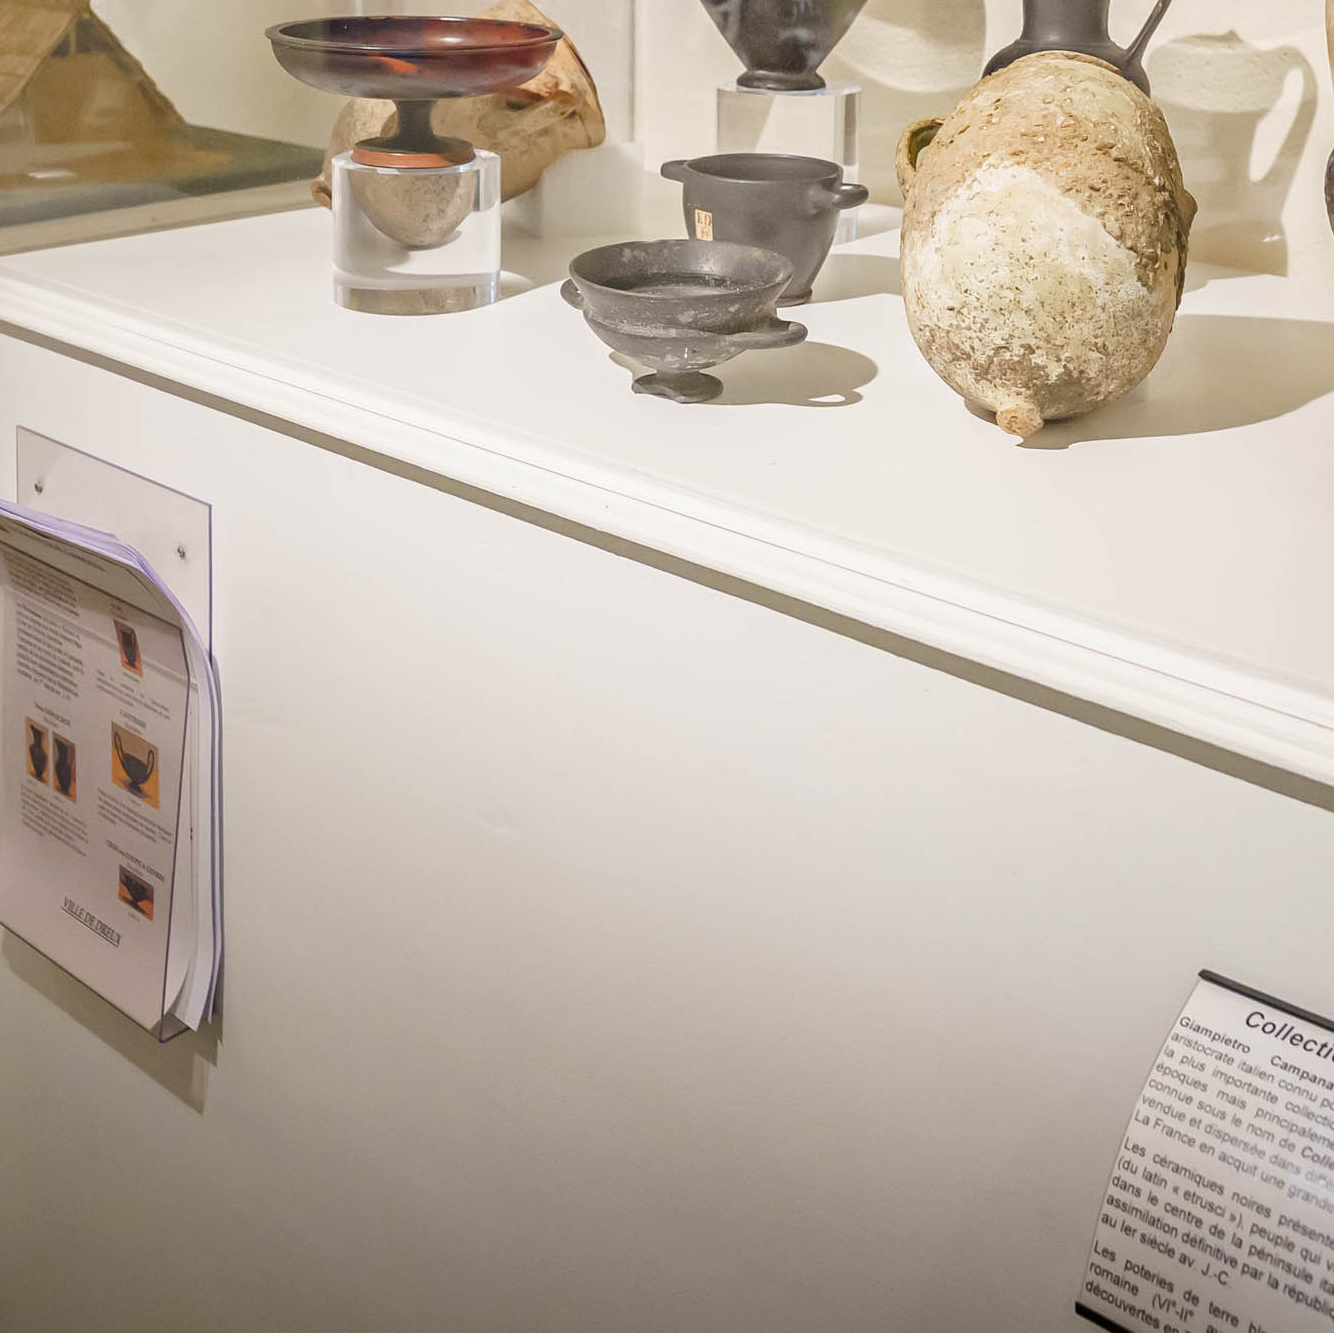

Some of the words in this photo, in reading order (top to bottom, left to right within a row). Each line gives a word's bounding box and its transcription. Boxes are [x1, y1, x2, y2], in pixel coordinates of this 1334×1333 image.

[84, 912, 97, 927] DE
[1155, 1061, 1208, 1092] époques
[1216, 1090, 1247, 1110] mais
[1163, 1045, 1175, 1058] la
[1179, 1055, 1206, 1073] plus
[1212, 1066, 1278, 1104] importante
[1170, 1032, 1235, 1065] aristocrate
[1238, 1059, 1275, 1083] italien
[1278, 1079, 1319, 1102] connu
[1179, 1016, 1251, 1054] Giampietro
[1270, 1055, 1334, 1090] Campana
[1134, 1109, 1150, 1126] La
[1153, 1118, 1196, 1148] France
[1199, 1142, 1216, 1156] en
[1218, 1151, 1258, 1174] acquit
[1260, 1170, 1287, 1189] une
[1142, 1093, 1187, 1122] vendue
[1189, 1117, 1202, 1130] et
[1204, 1122, 1266, 1160] dispersée
[1269, 1153, 1301, 1175] dans
[1148, 1077, 1194, 1105] connue
[1197, 1100, 1227, 1121] sous
[1230, 1113, 1243, 1128] le
[1246, 1121, 1275, 1144] nom
[1278, 1136, 1296, 1153] de
[1117, 1155, 1138, 1175] (du
[1141, 1169, 1168, 1190] latin
[1183, 1190, 1226, 1218] etrusci
[1249, 1222, 1296, 1254] peuple
[1300, 1246, 1321, 1266] qui
[1124, 1136, 1146, 1157] Les
[1152, 1152, 1225, 1195] céramiques
[1231, 1191, 1272, 1218] noires
[1101, 1212, 1116, 1228] au
[1139, 1232, 1175, 1259] siècle
[1106, 1193, 1178, 1238] assimilation
[1181, 1231, 1238, 1268] définitive
[1241, 1263, 1264, 1281] par
[1267, 1274, 1279, 1290] la
[1112, 1175, 1141, 1198] dans
[1147, 1191, 1159, 1206] le
[1164, 1201, 1203, 1229] centre
[1209, 1223, 1226, 1240] de
[1231, 1233, 1244, 1249] la
[1248, 1244, 1314, 1284] péninsule
[1085, 1280, 1160, 1330] découvertes
[1089, 1261, 1139, 1296] romaine
[1094, 1240, 1116, 1262] Les
[1124, 1258, 1174, 1293] poteries
[1183, 1289, 1200, 1306] de
[1208, 1300, 1239, 1328] terre
